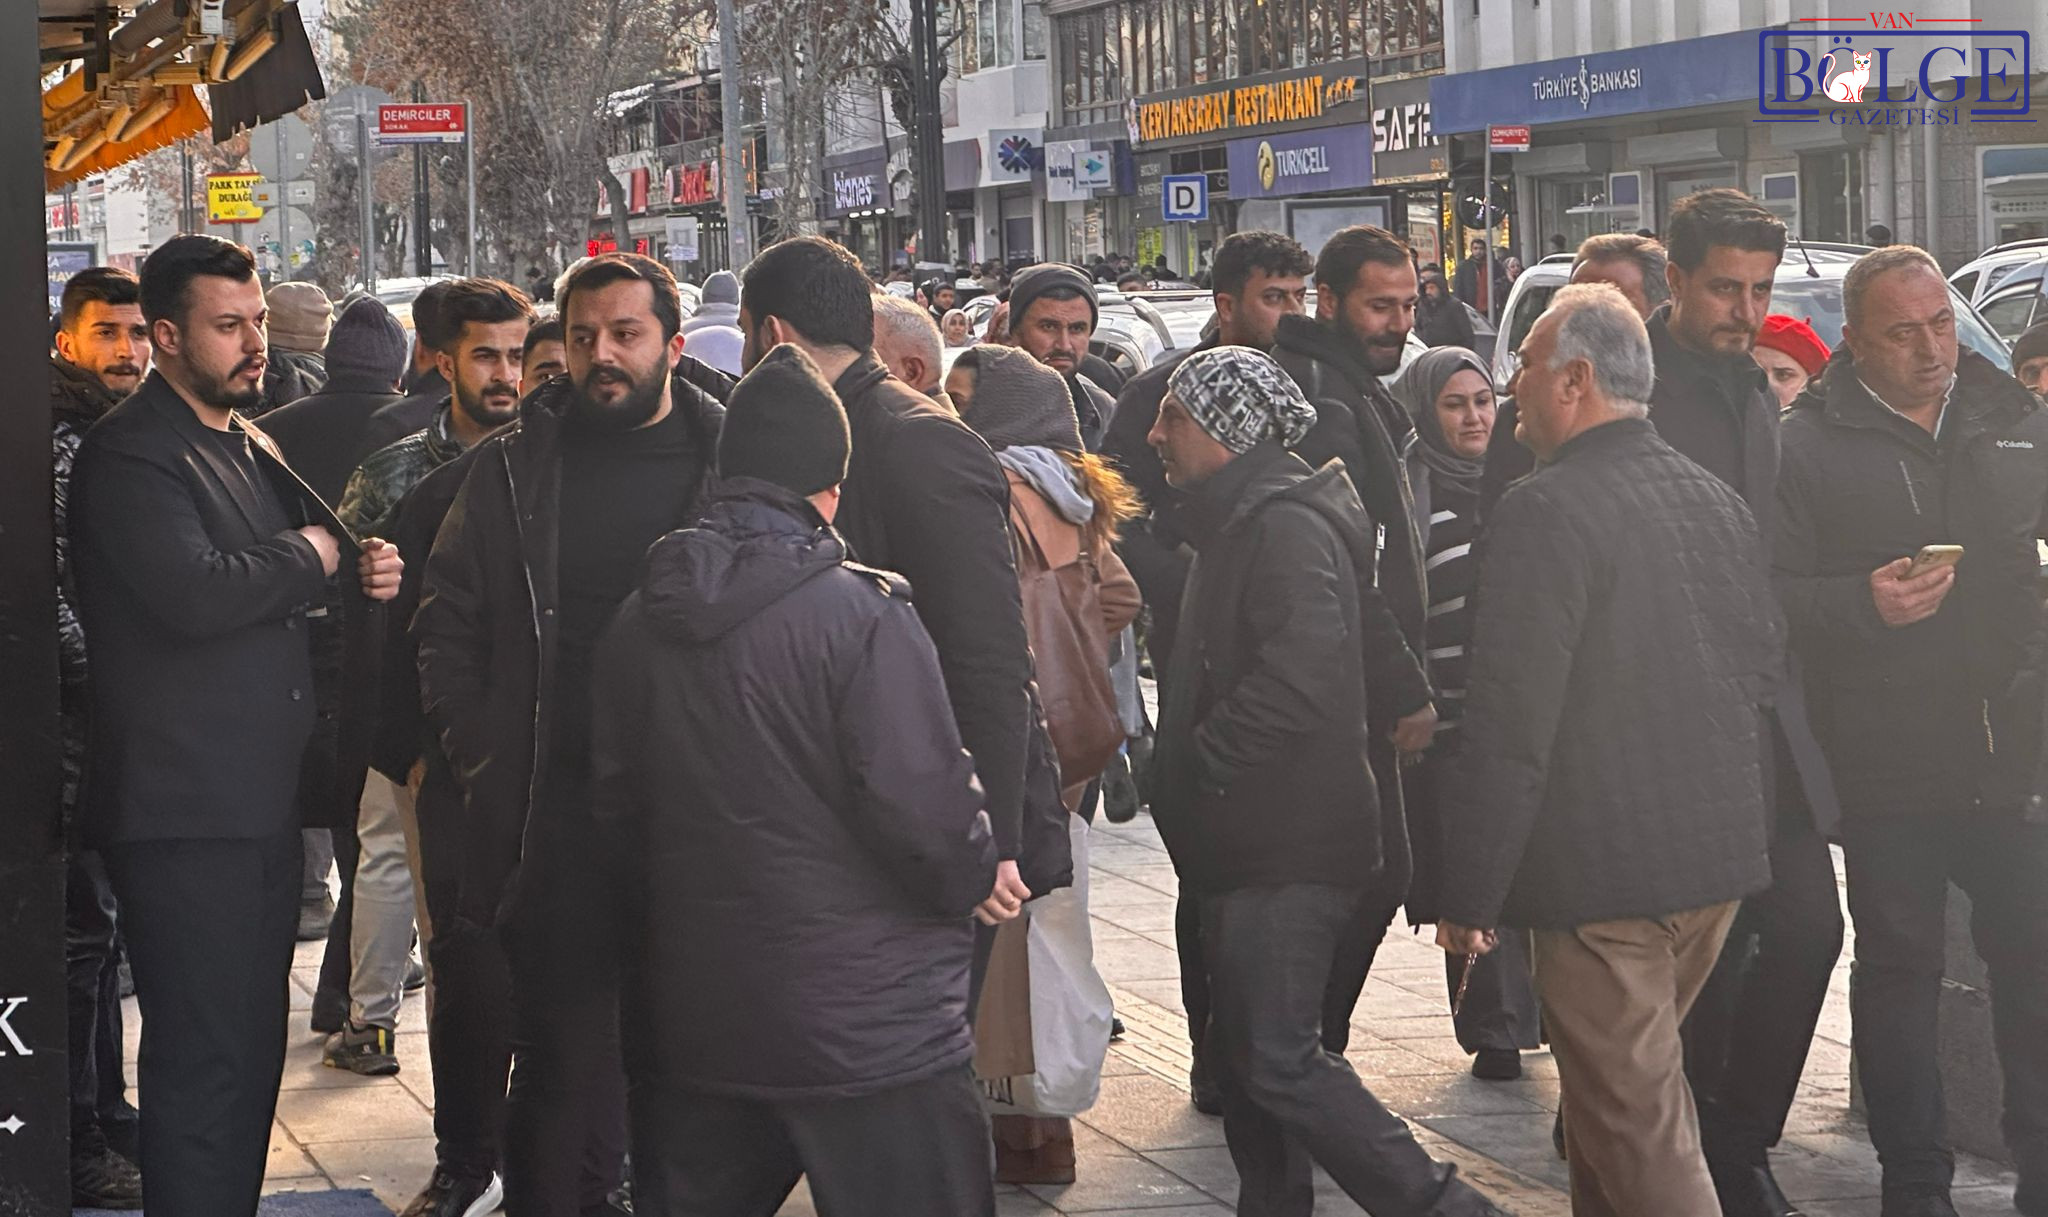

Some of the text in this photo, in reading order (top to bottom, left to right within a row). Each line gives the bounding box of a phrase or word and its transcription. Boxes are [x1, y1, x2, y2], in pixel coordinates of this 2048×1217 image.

[1533, 73, 1578, 100] TÜRKİYE
[1591, 68, 1641, 93] BANKASI
[1140, 75, 1324, 141] KERVANSARAY RESTAURANT
[1275, 146, 1330, 177] TURKCELL
[210, 180, 232, 190] PARK
[1175, 185, 1195, 210] D
